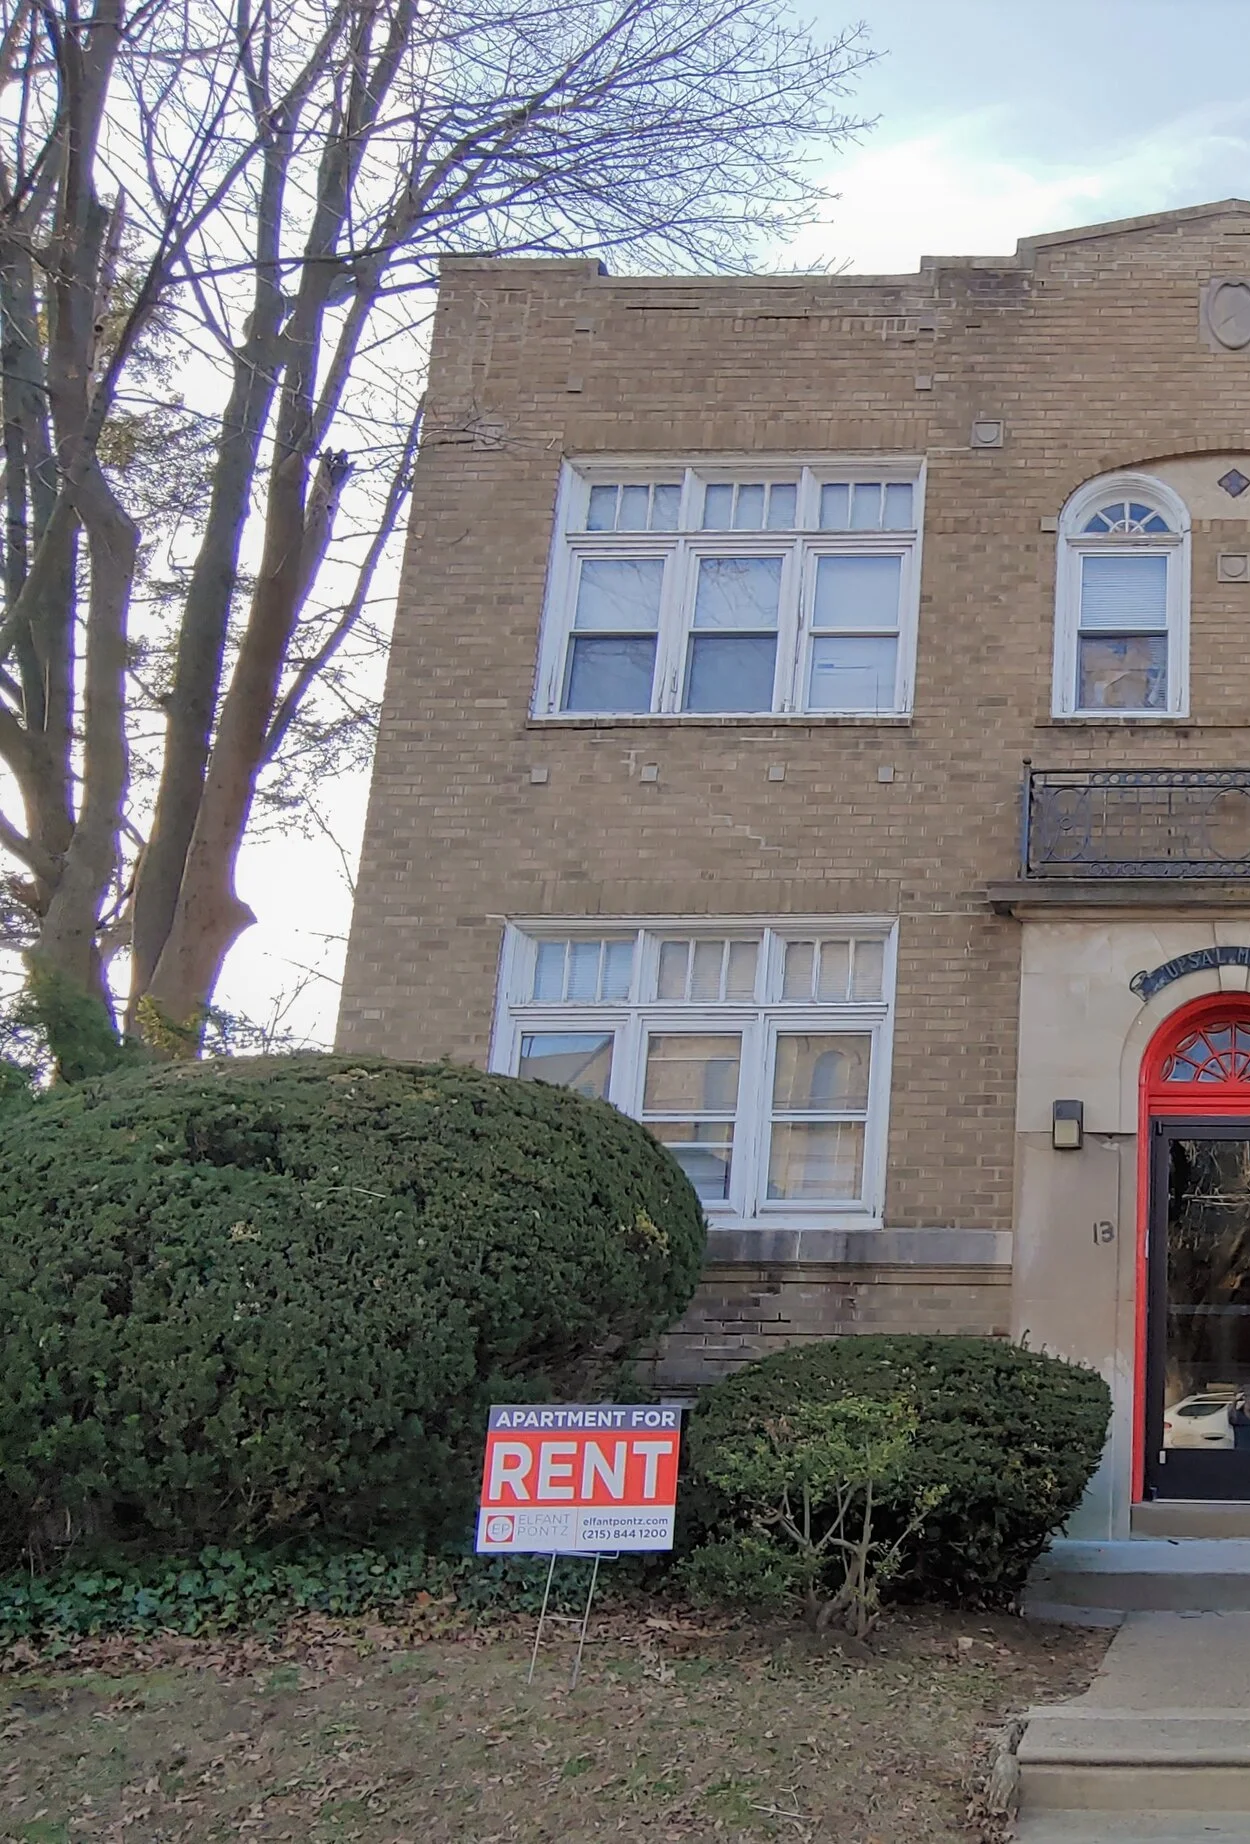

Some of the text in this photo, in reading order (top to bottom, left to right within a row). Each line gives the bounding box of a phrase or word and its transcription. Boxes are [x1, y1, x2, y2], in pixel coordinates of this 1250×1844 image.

[1164, 947, 1226, 978] UPSAL
[496, 1410, 675, 1427] APARTMENT FOR
[488, 1440, 674, 1500] RENT
[518, 1513, 571, 1525] ELFANT
[583, 1516, 669, 1527] elfantpontz.com
[491, 1522, 511, 1536] EP
[517, 1525, 569, 1537] PONTZ
[582, 1528, 668, 1540] (215) 844 1200
